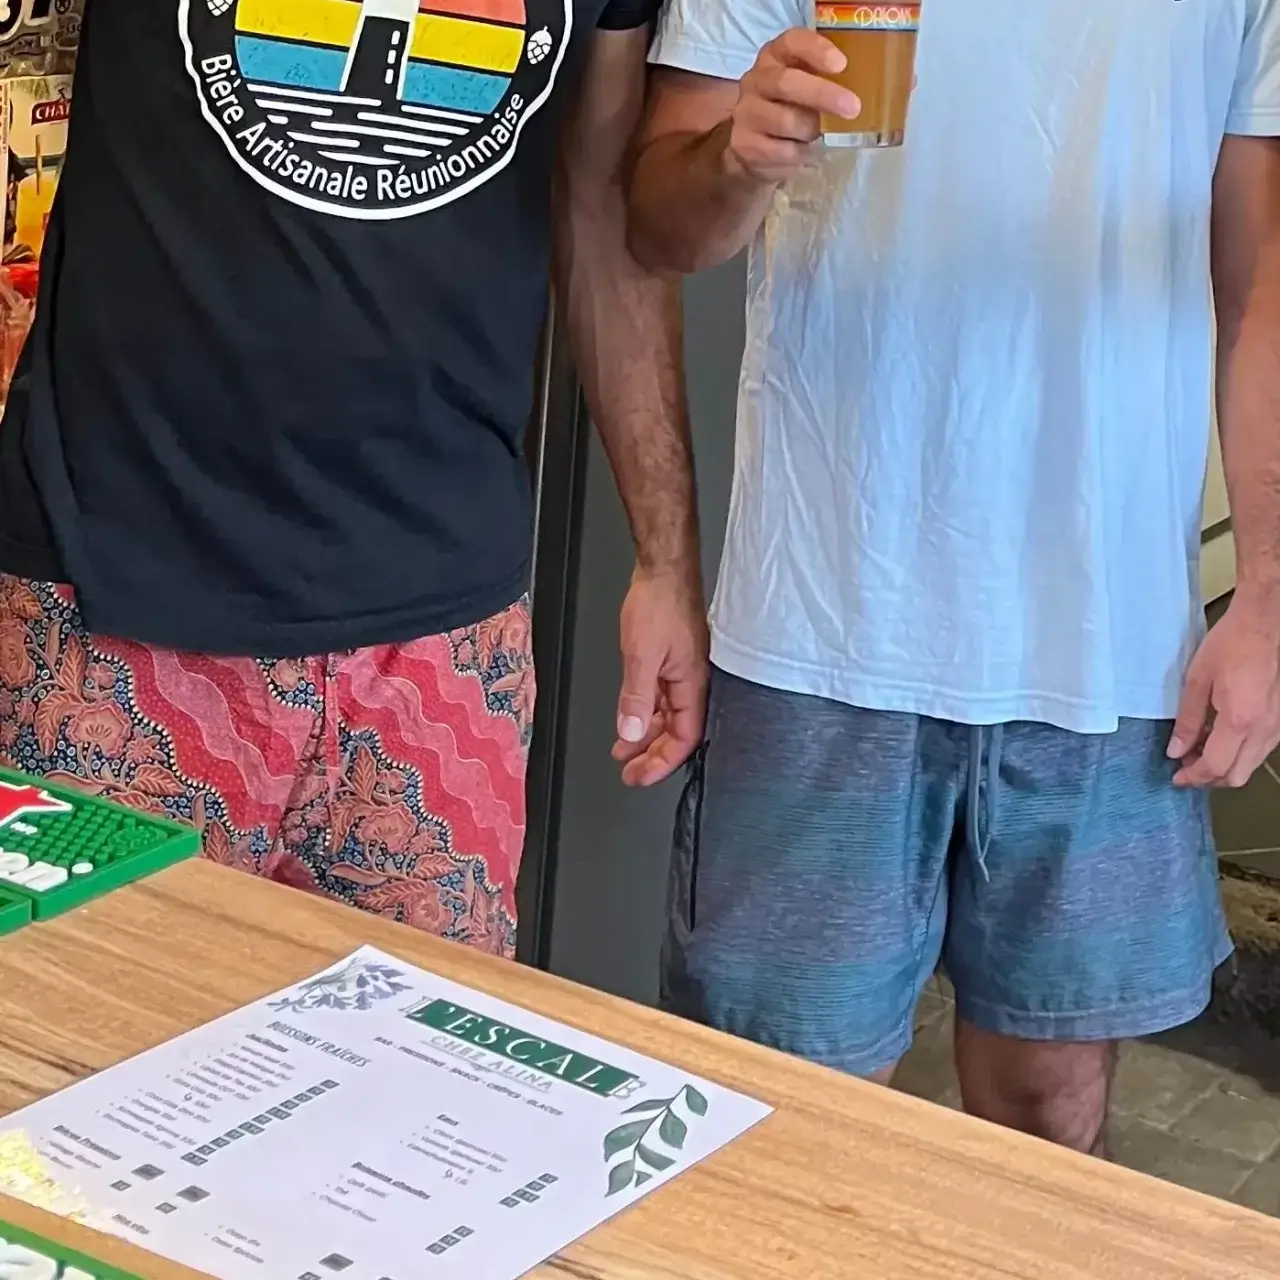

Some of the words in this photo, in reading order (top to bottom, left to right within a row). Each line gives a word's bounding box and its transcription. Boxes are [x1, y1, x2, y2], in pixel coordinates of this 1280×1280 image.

[201, 53, 246, 126] Bière
[236, 122, 367, 201] Artisanale
[376, 92, 524, 201] Réunionnaise
[398, 995, 647, 1099] L'ESCALE
[429, 1035, 481, 1062] CHEZ
[489, 1060, 555, 1091] ALINA
